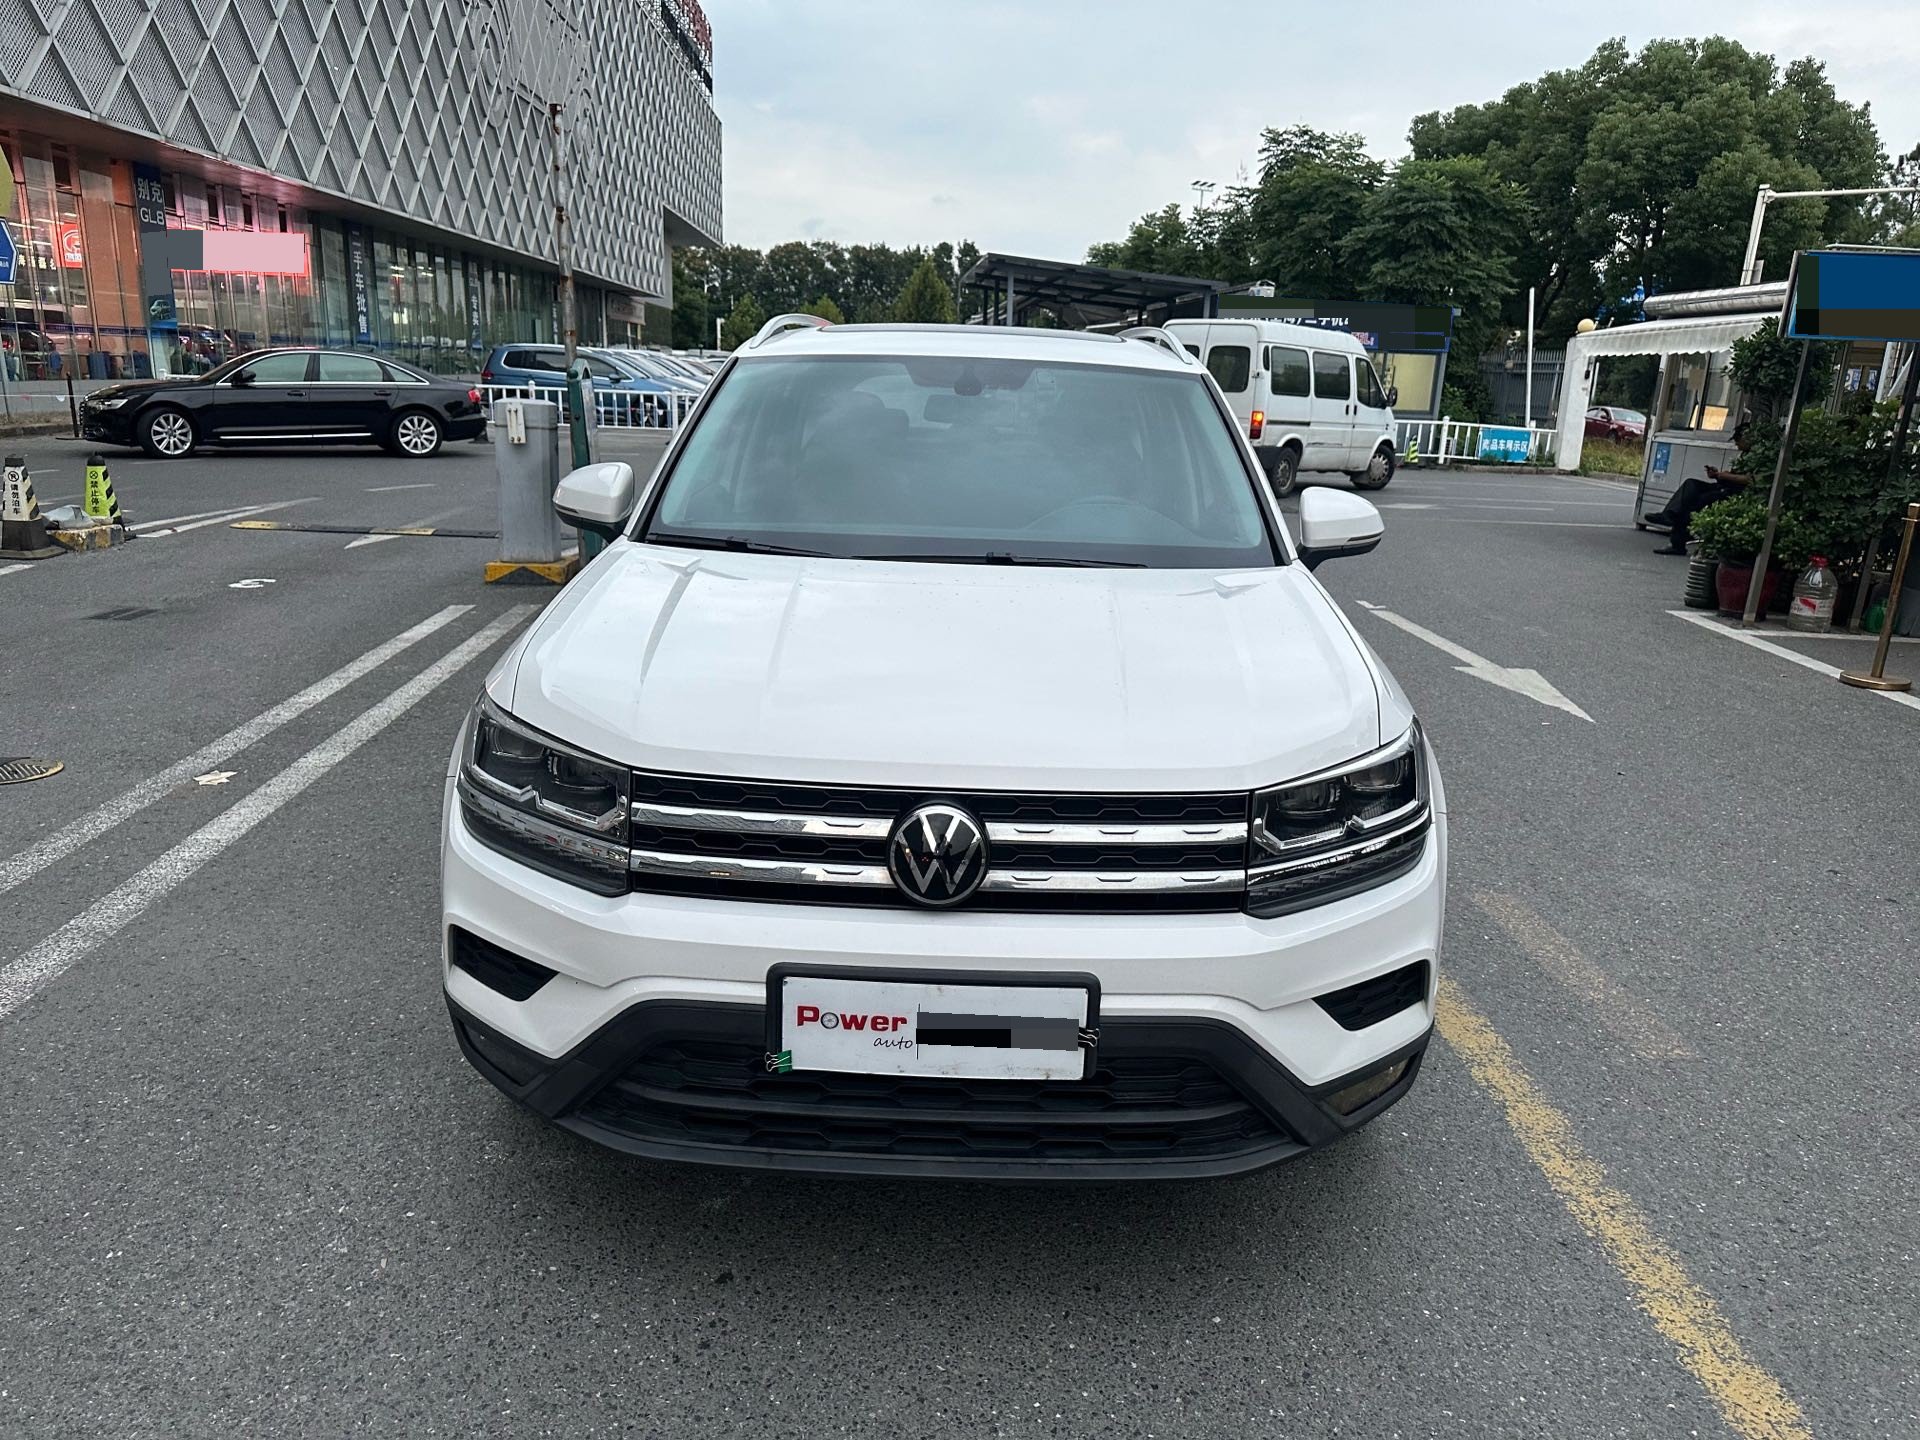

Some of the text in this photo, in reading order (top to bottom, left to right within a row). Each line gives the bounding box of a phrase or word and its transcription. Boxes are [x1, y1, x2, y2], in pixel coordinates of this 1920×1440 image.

[137, 177, 163, 203] 别克
[140, 207, 165, 226] GL8
[352, 231, 367, 333] 二手车批售
[1482, 438, 1528, 452] 商品车展示区
[10, 484, 20, 515] 请勿泊车
[90, 481, 100, 513] 禁止停车
[797, 1005, 908, 1032] Power
[873, 1036, 914, 1050] auto
